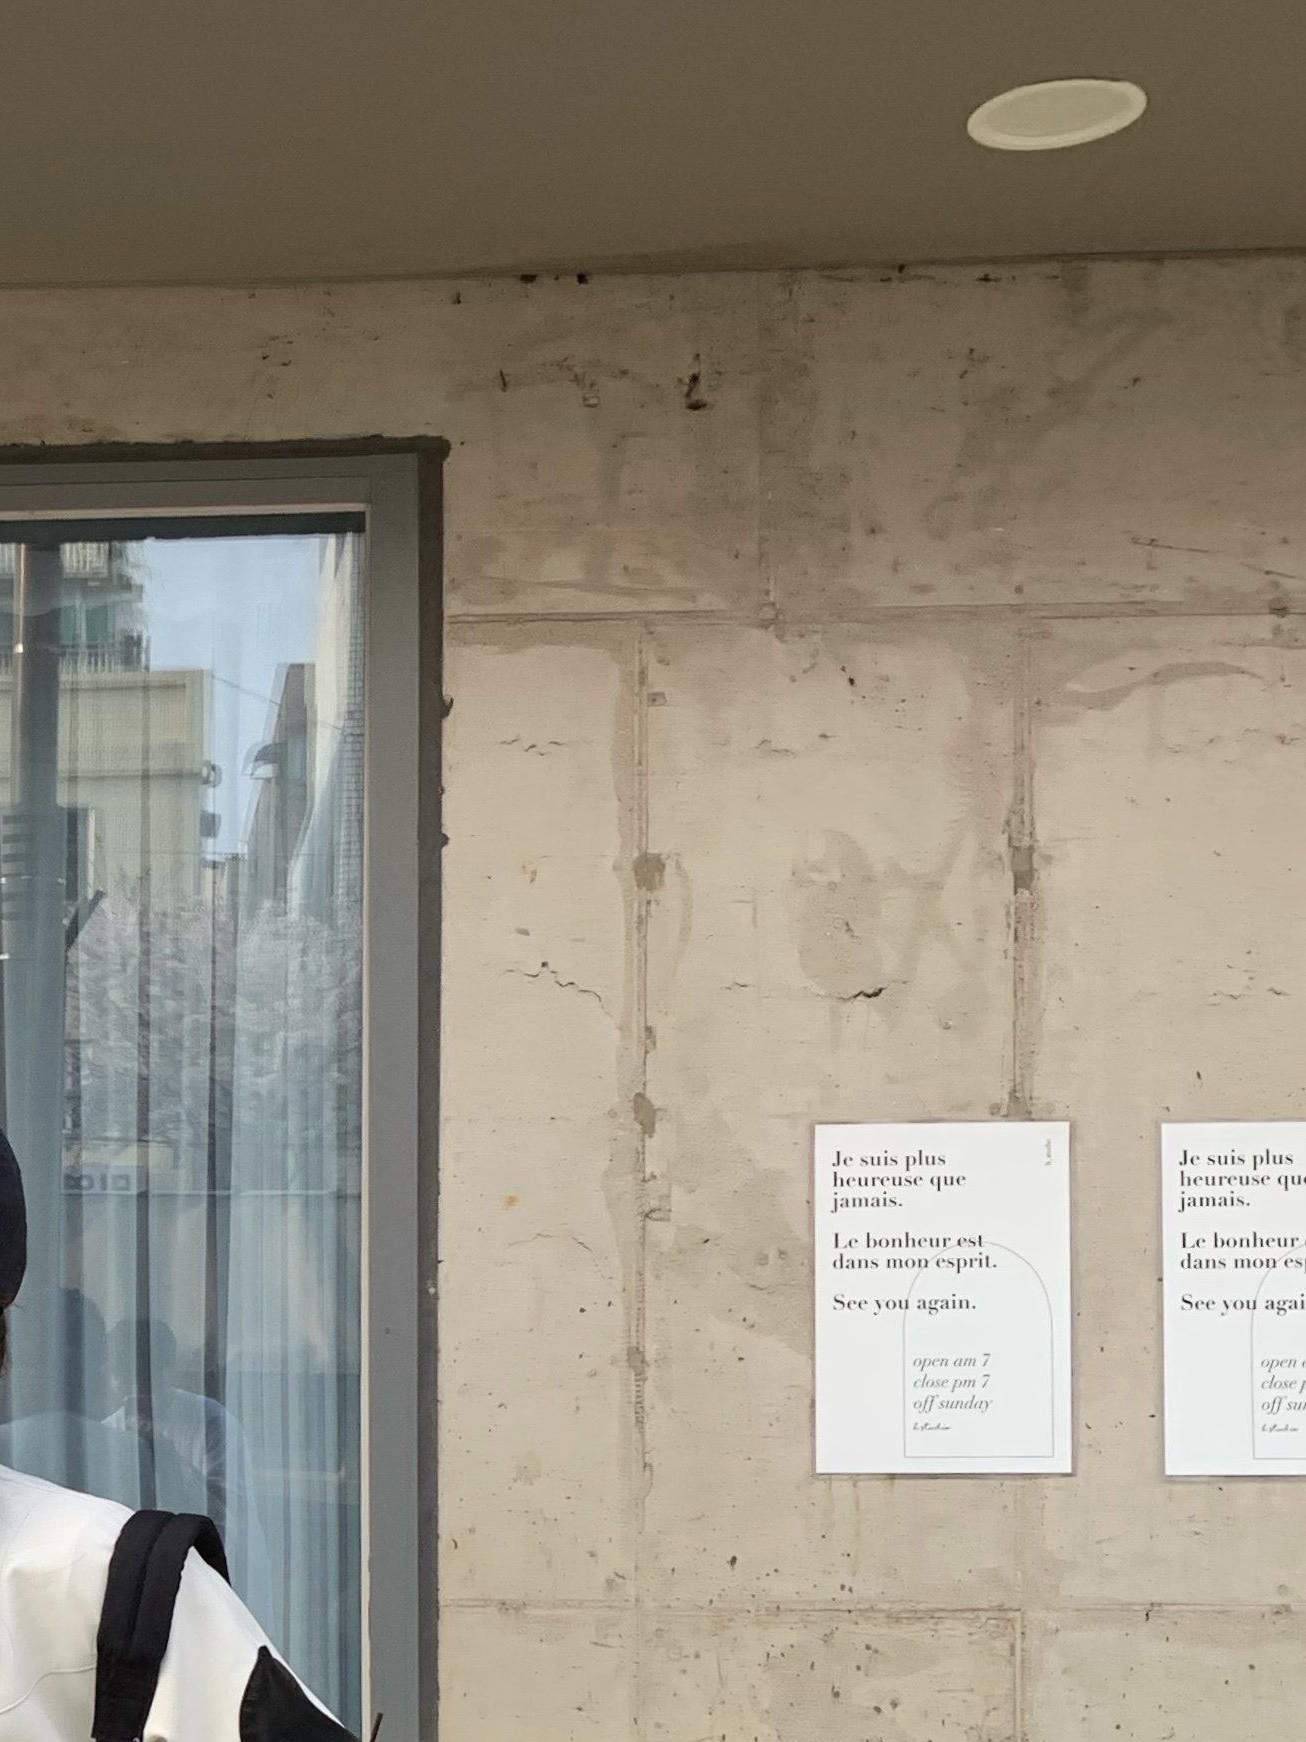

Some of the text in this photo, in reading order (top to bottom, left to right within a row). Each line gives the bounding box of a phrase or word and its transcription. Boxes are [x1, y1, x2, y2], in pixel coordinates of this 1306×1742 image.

[832, 1150, 946, 1171] Je suis plus
[1179, 1148, 1294, 1171] Je suis plus
[833, 1171, 966, 1192] heureuse que
[1180, 1171, 1271, 1187] heureuse
[831, 1191, 903, 1213] jamais.
[1178, 1191, 1251, 1213] jamais.
[834, 1232, 983, 1249] Le bonheur est
[1181, 1232, 1206, 1249] Le
[1213, 1231, 1299, 1248] bonheur
[833, 1252, 997, 1274] dans mon esprit.
[1180, 1253, 1226, 1270] dans
[1234, 1257, 1277, 1269] mon
[833, 1293, 976, 1316] See you again.
[1181, 1293, 1216, 1311] See
[1221, 1298, 1257, 1316] you
[913, 1353, 991, 1371] open am 7
[1261, 1358, 1297, 1372] open
[913, 1373, 991, 1393] close pm 7
[1261, 1374, 1297, 1389] close
[913, 1395, 993, 1414] off sunday
[1261, 1396, 1288, 1415] off
